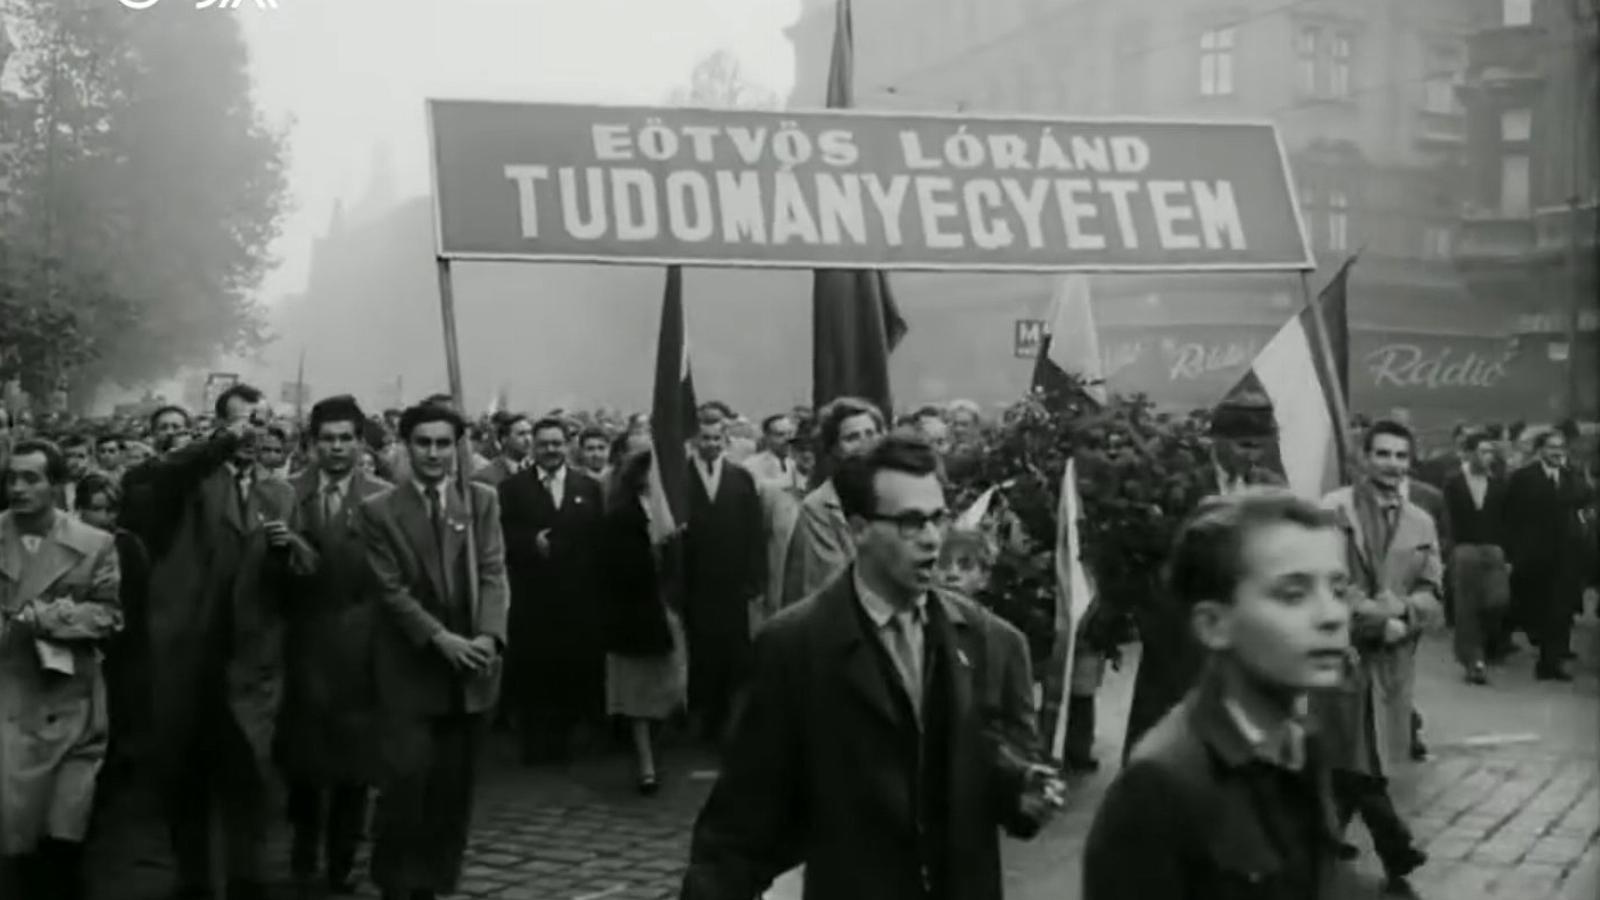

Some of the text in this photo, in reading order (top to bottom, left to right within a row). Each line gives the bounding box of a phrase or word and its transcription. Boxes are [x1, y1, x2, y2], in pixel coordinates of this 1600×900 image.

[590, 117, 1151, 173] EÖTVÖS LÓRÁND
[504, 164, 1247, 251] TUDOMÁNYEGYETEM
